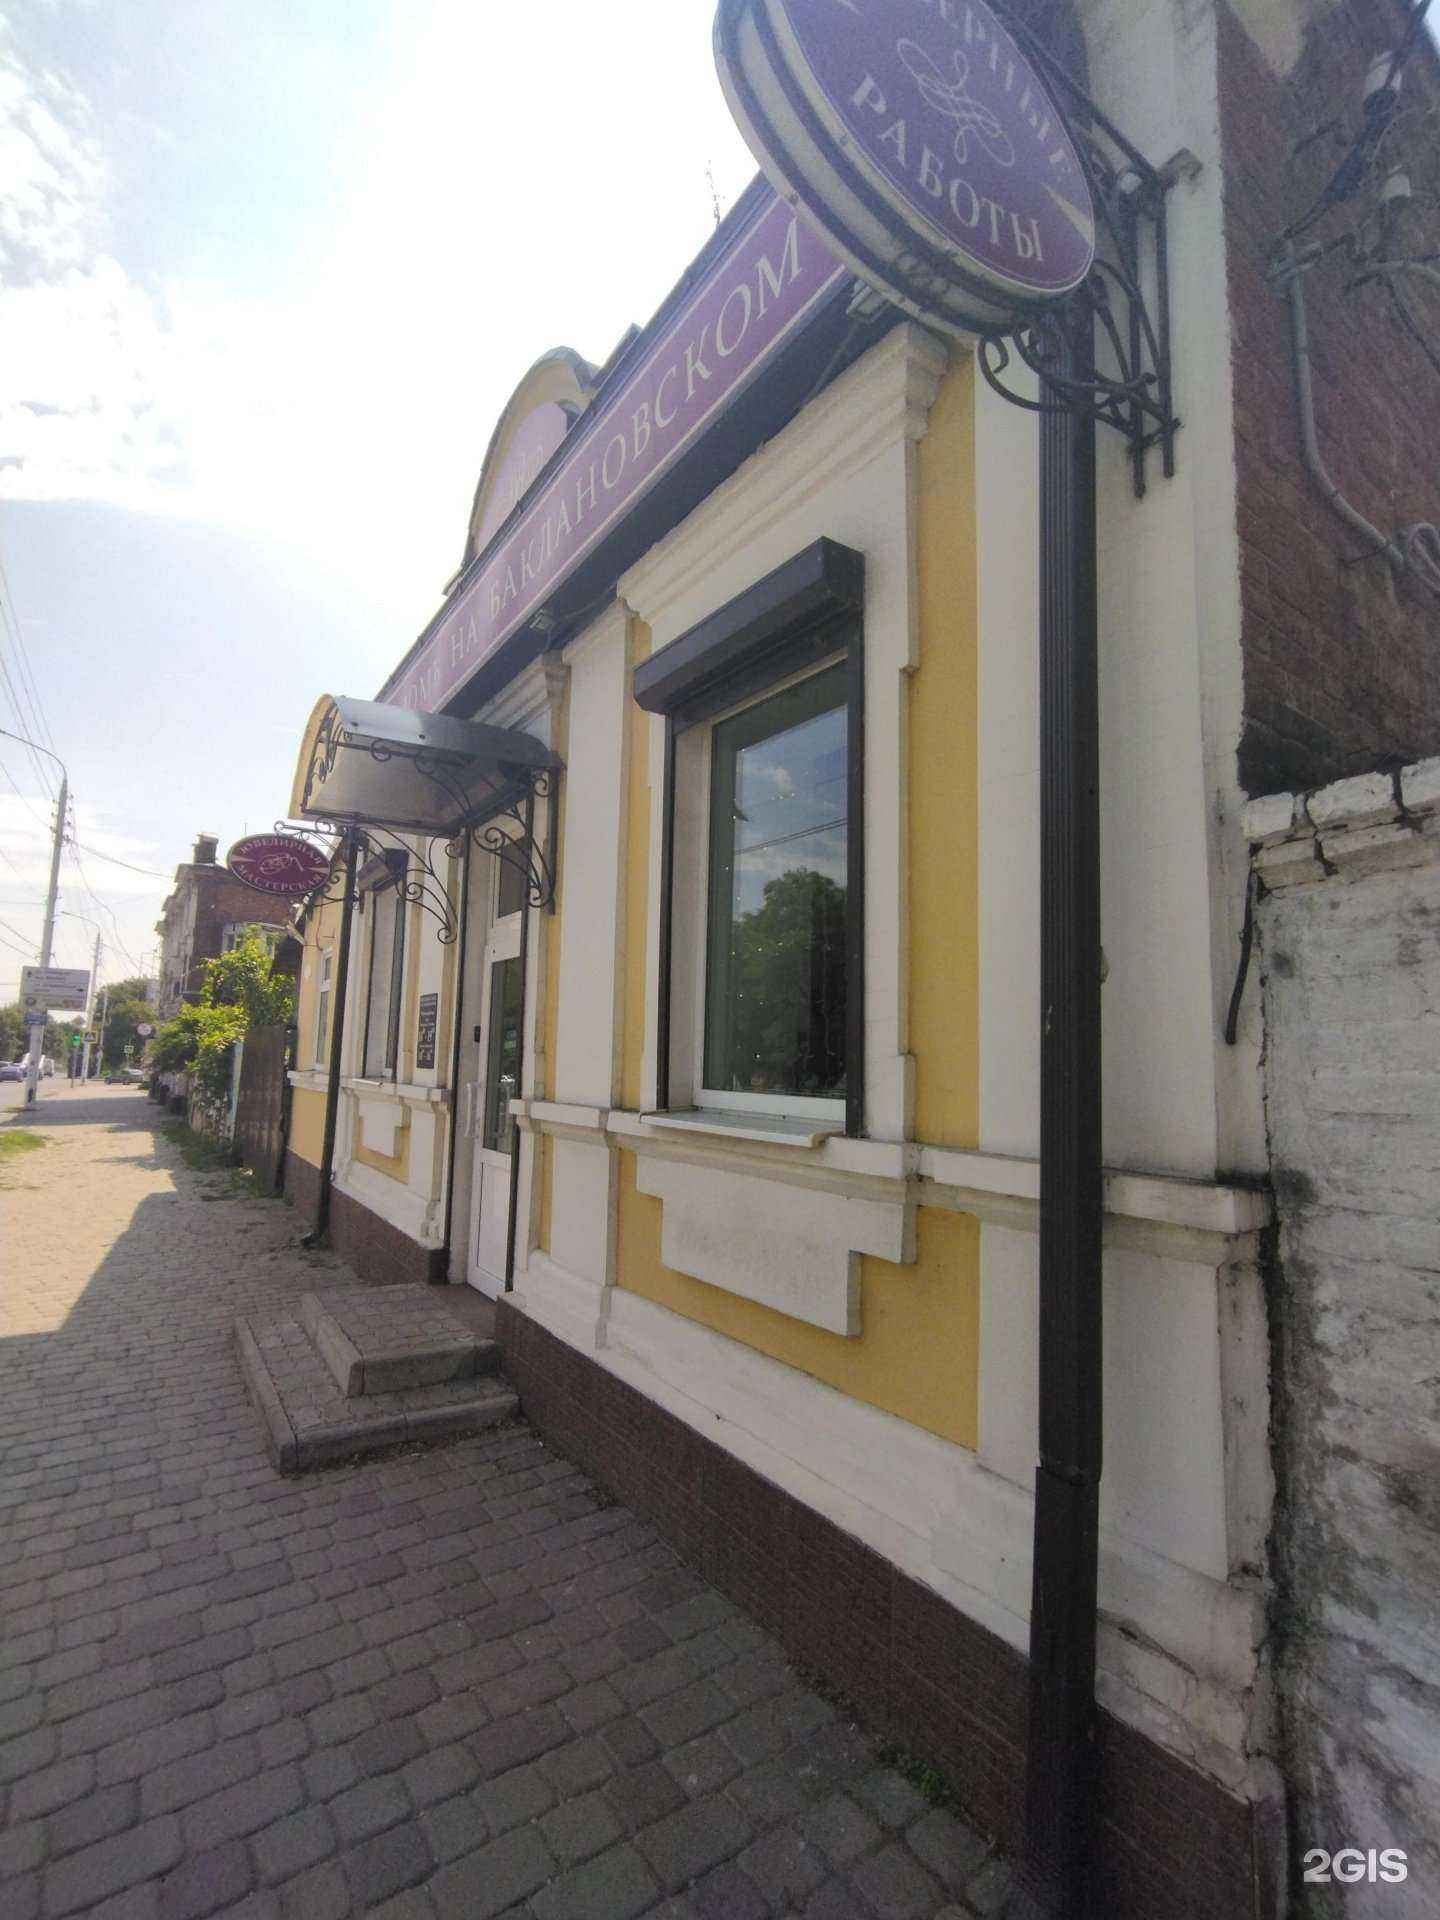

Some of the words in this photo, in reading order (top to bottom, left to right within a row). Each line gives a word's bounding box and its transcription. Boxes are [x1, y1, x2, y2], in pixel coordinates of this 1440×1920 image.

[853, 73, 1046, 262] РАБОТЫ
[450, 615, 479, 668] НА
[487, 216, 803, 622] БАКЛАНОВСКОМ
